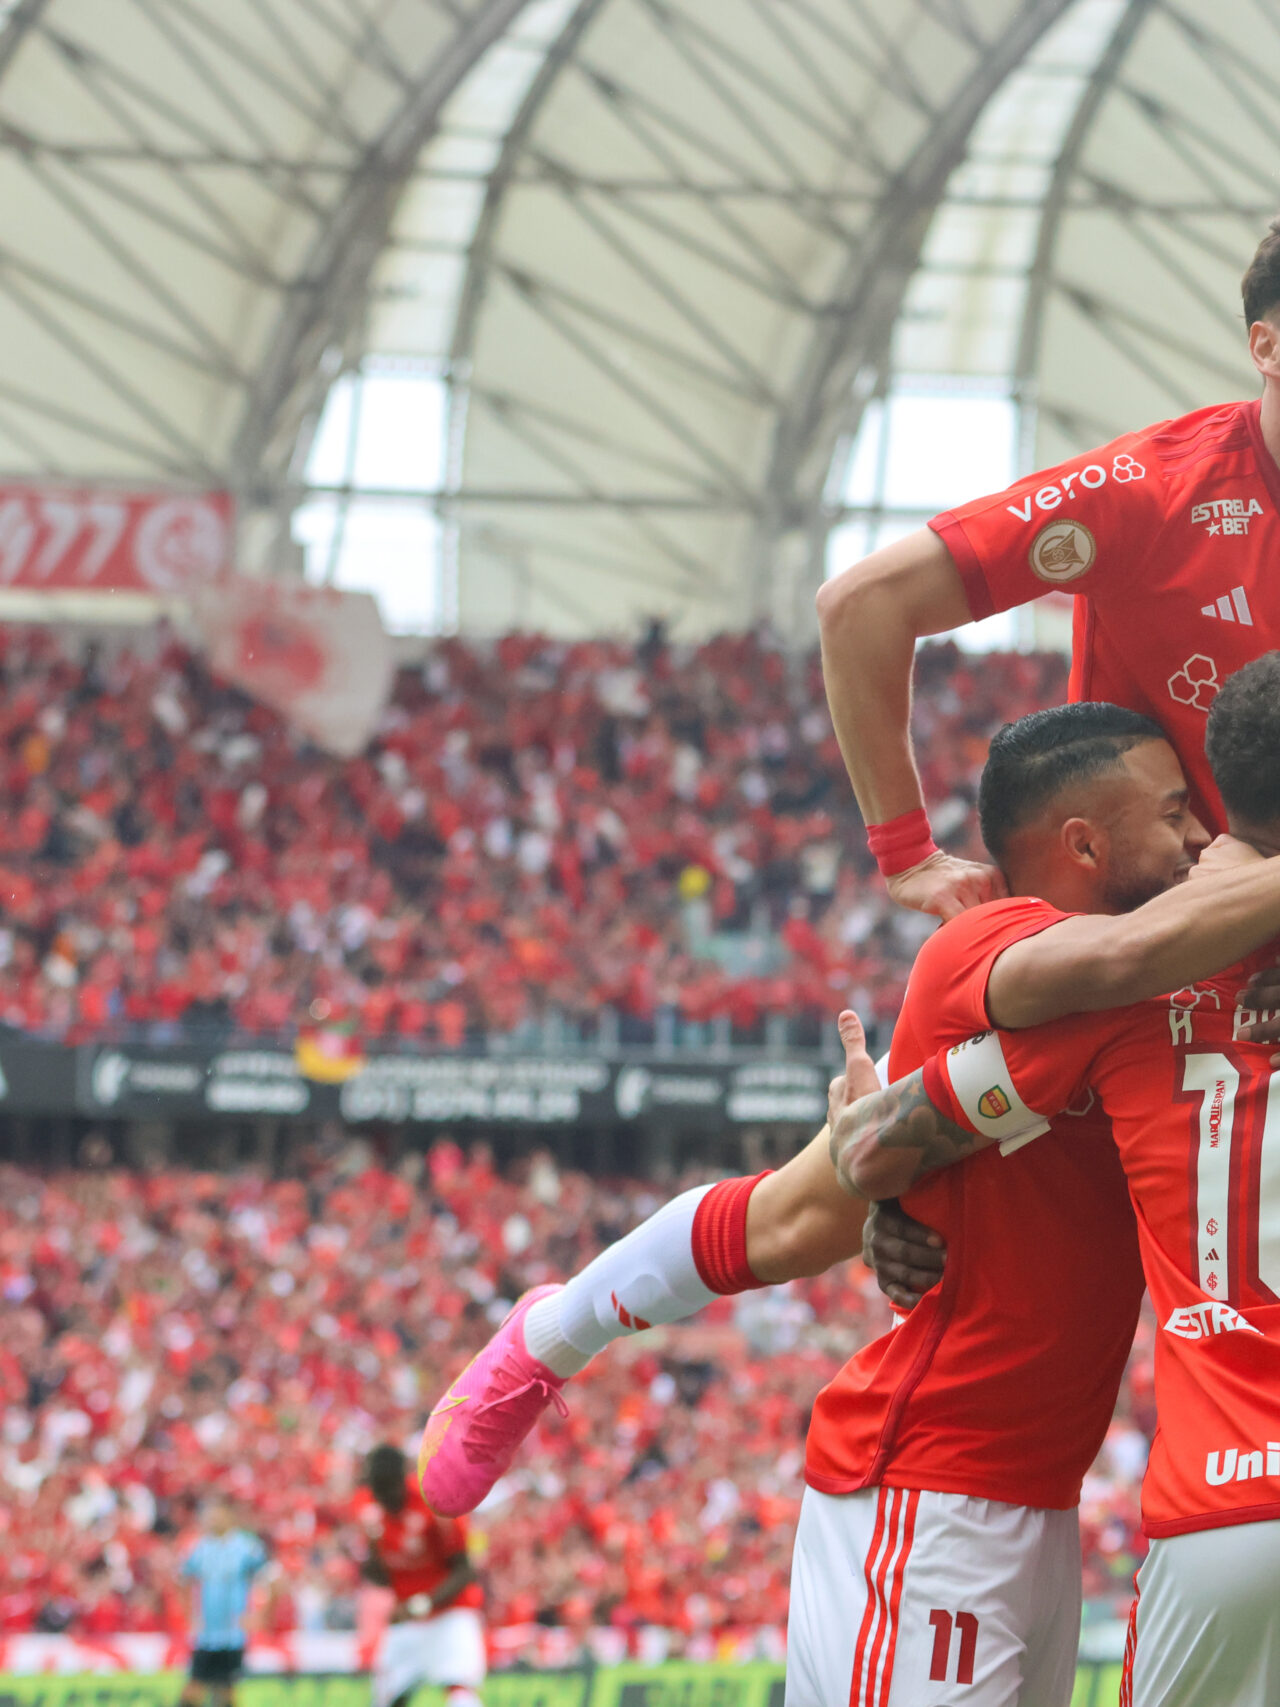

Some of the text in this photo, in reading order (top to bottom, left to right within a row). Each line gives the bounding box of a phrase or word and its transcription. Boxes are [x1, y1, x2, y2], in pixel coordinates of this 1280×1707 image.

[1006, 465, 1107, 523] vero
[1191, 498, 1264, 524] ESTRELA
[1223, 517, 1250, 536] BET
[1209, 1079, 1226, 1149] MARQUESPAN
[928, 1608, 979, 1685] 11
